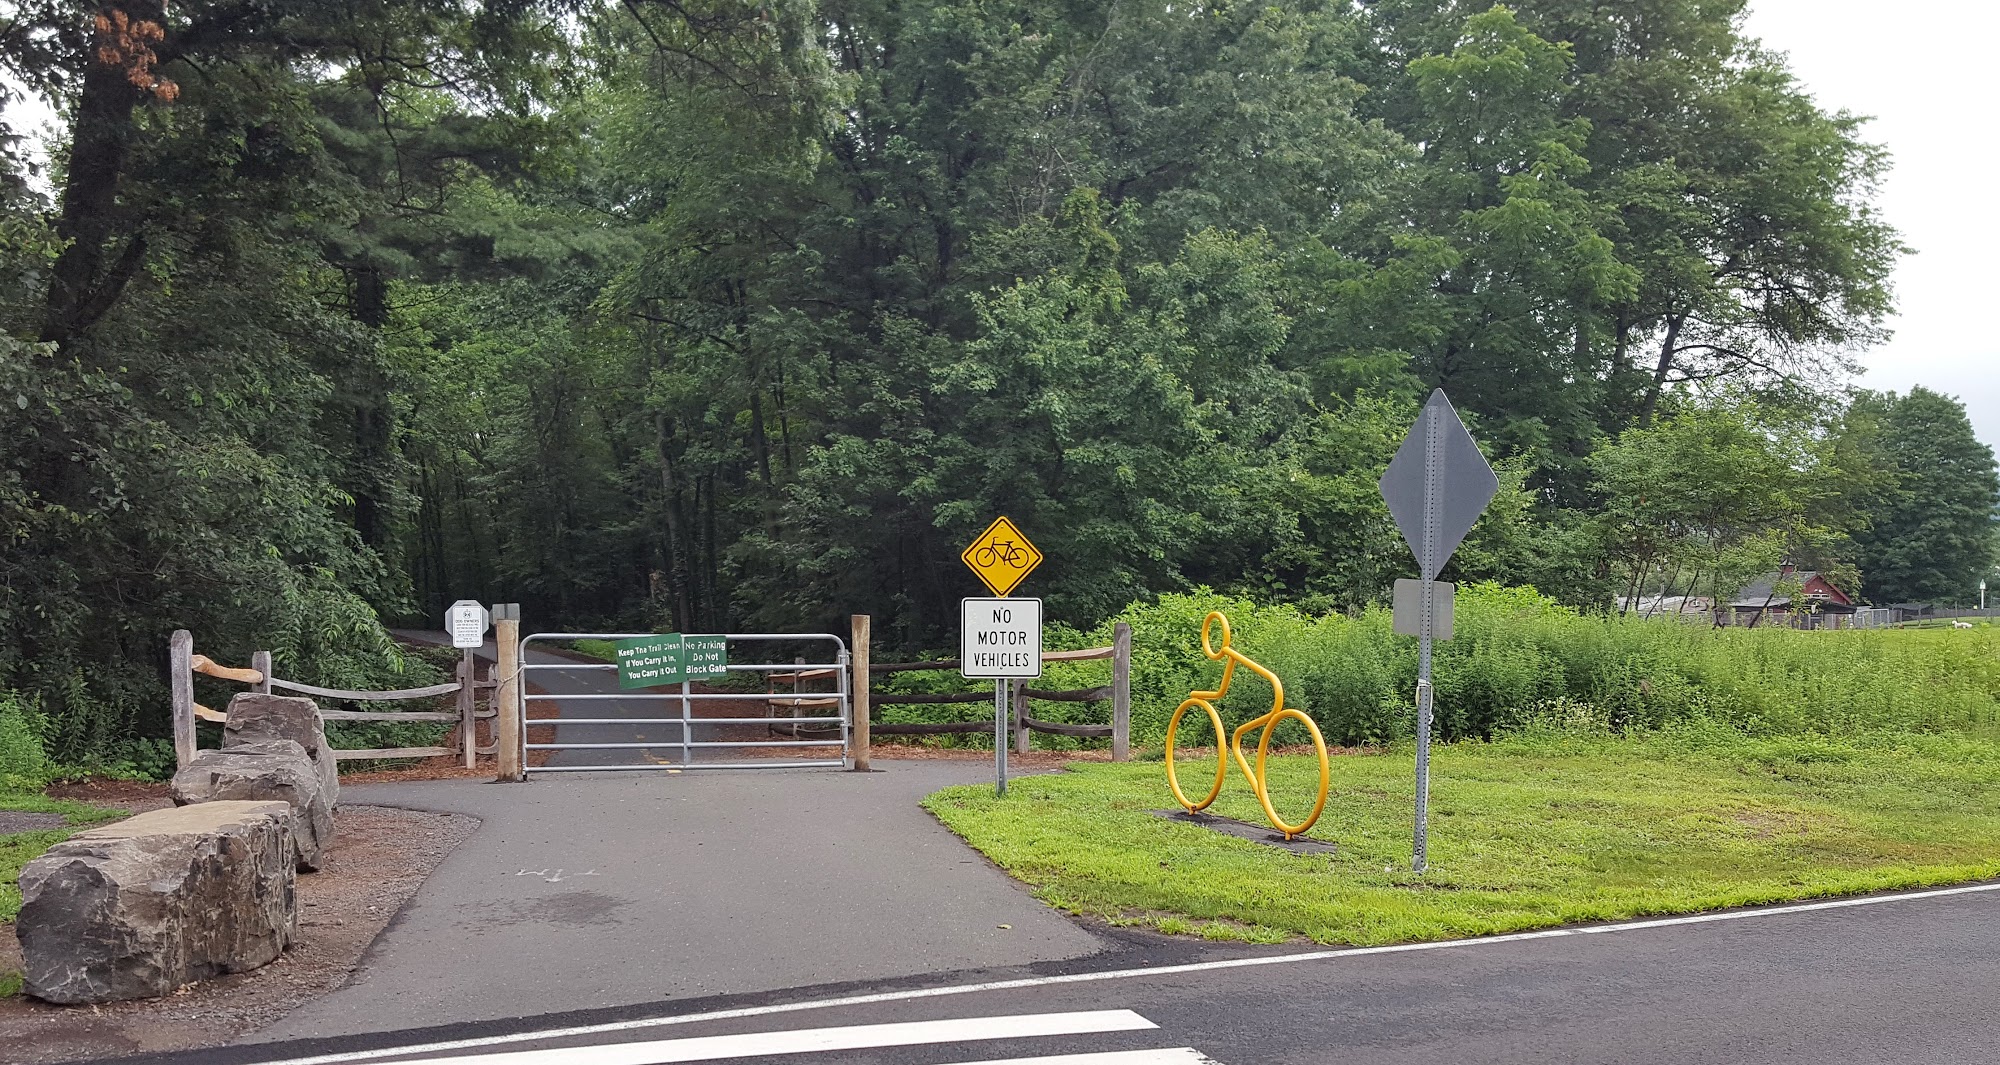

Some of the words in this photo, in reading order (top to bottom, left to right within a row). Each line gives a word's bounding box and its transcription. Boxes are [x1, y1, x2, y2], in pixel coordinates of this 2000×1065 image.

[993, 610, 1011, 623] NO
[978, 631, 1027, 645] MOTOR
[618, 649, 634, 657] Keep
[648, 644, 661, 652] Trail
[685, 642, 695, 650] No
[698, 640, 725, 650] Parking
[693, 653, 703, 661] Do
[706, 652, 718, 660] Not
[974, 653, 1029, 667] VEHICLES
[686, 665, 707, 673] Block
[709, 664, 726, 672] Gate
